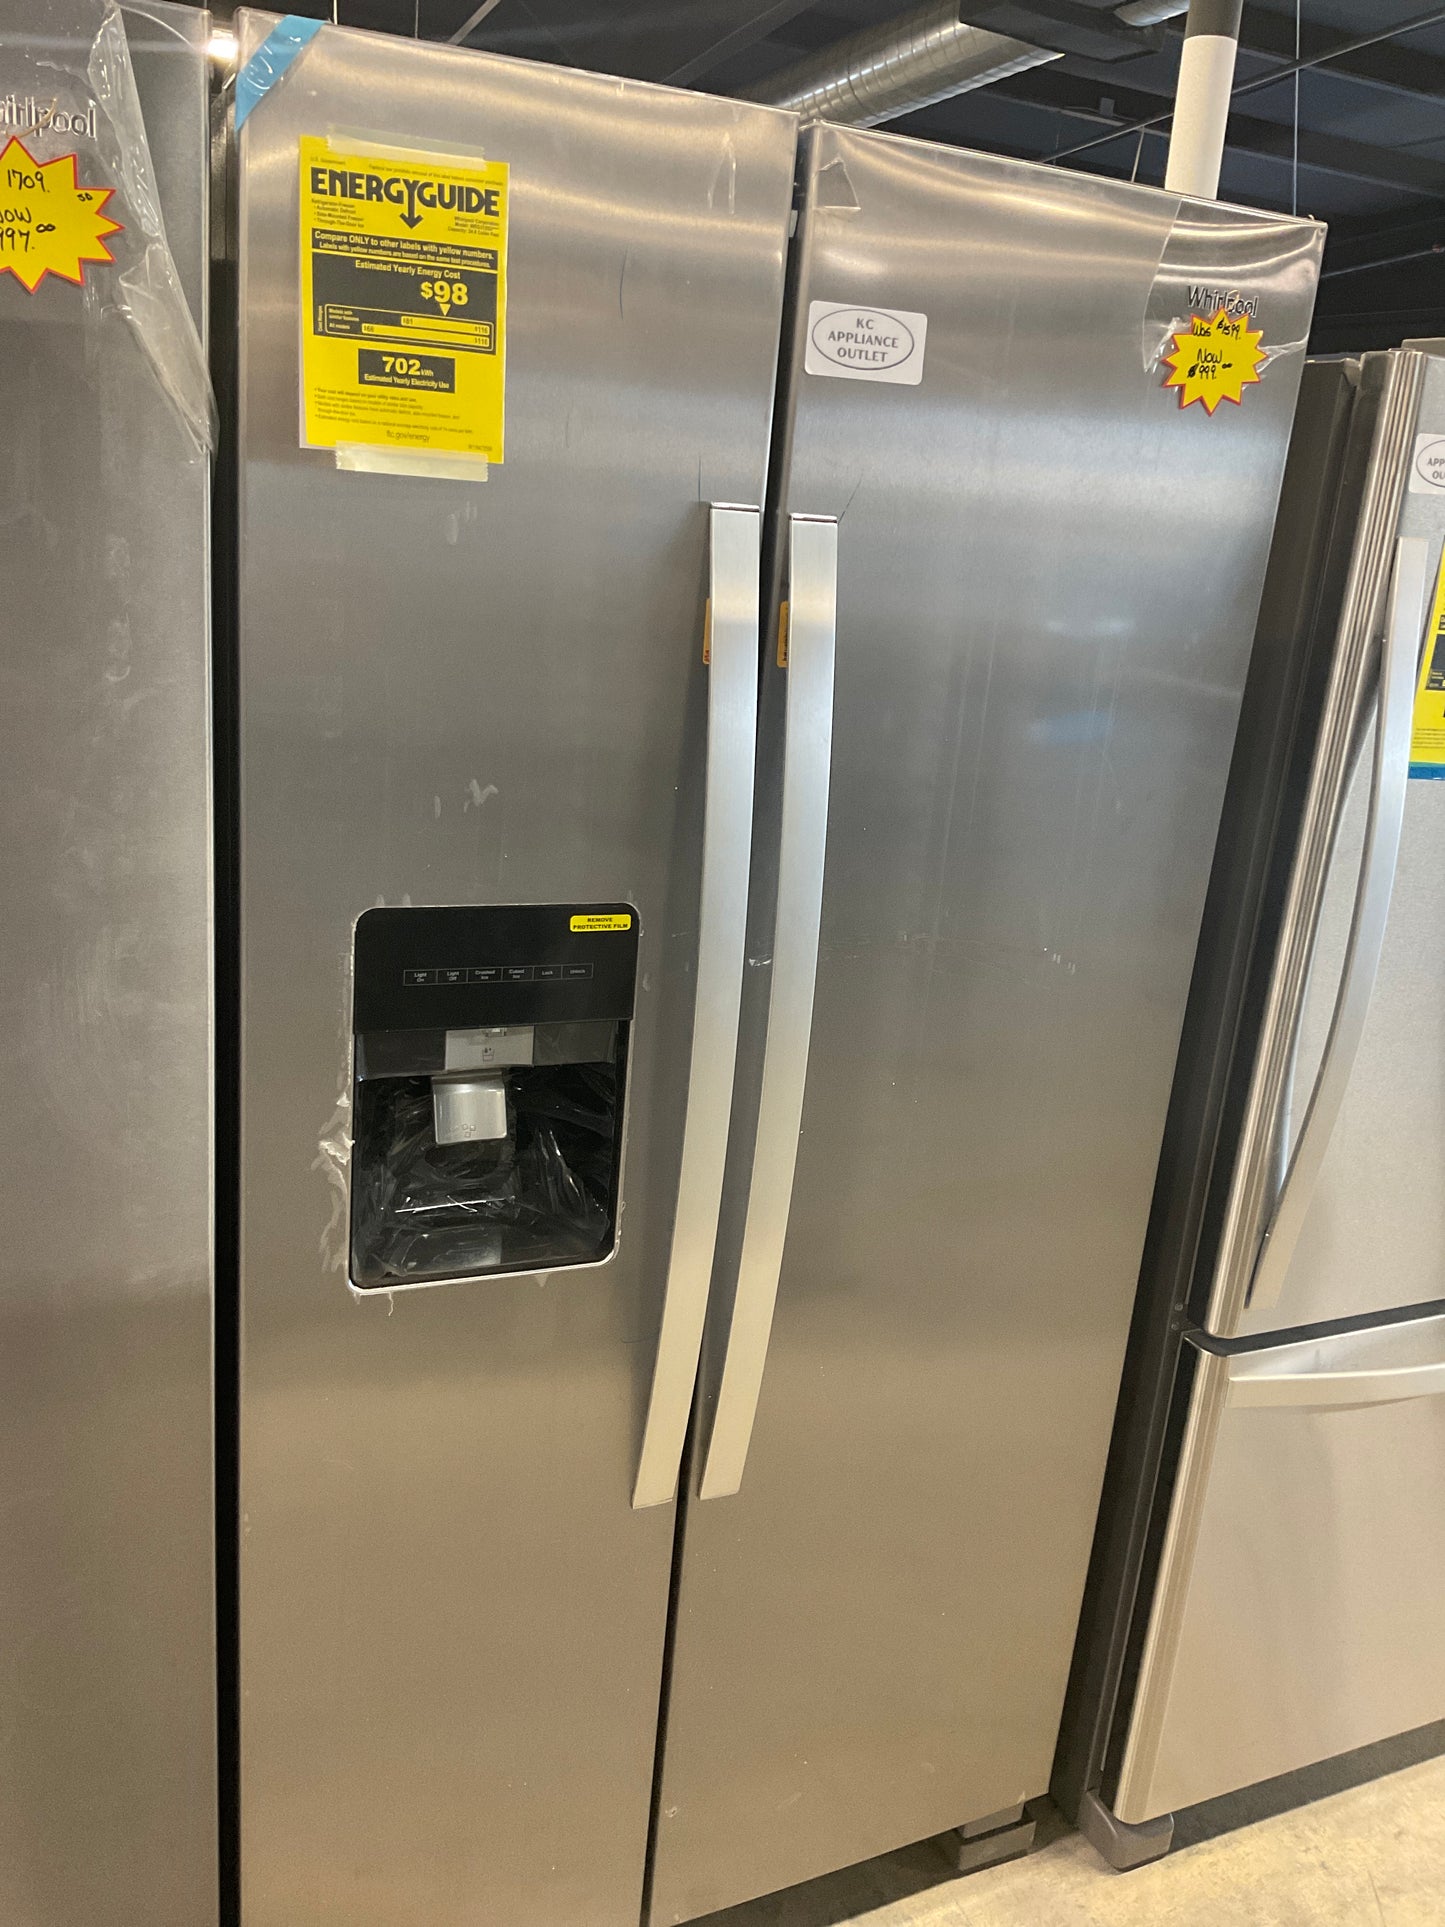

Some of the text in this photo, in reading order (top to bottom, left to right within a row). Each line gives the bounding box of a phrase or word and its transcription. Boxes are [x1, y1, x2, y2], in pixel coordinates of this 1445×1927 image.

[310, 166, 500, 218] ENERGYGUIDE
[314, 230, 495, 260] Compare ONLY to other labels with yellow numbers.
[319, 241, 338, 250] Labels
[368, 247, 392, 256] numbers
[355, 259, 461, 280] Estimated Yearly Energy Cost
[420, 280, 469, 306] $98
[1187, 285, 1259, 318] Whirlpool
[856, 318, 875, 330] KC
[827, 330, 899, 349] APPLIANCE
[837, 347, 888, 363] OUTLET
[1197, 348, 1222, 364] Now
[381, 356, 421, 376] 702
[364, 373, 450, 389] Estimated Yearly Electricity Use
